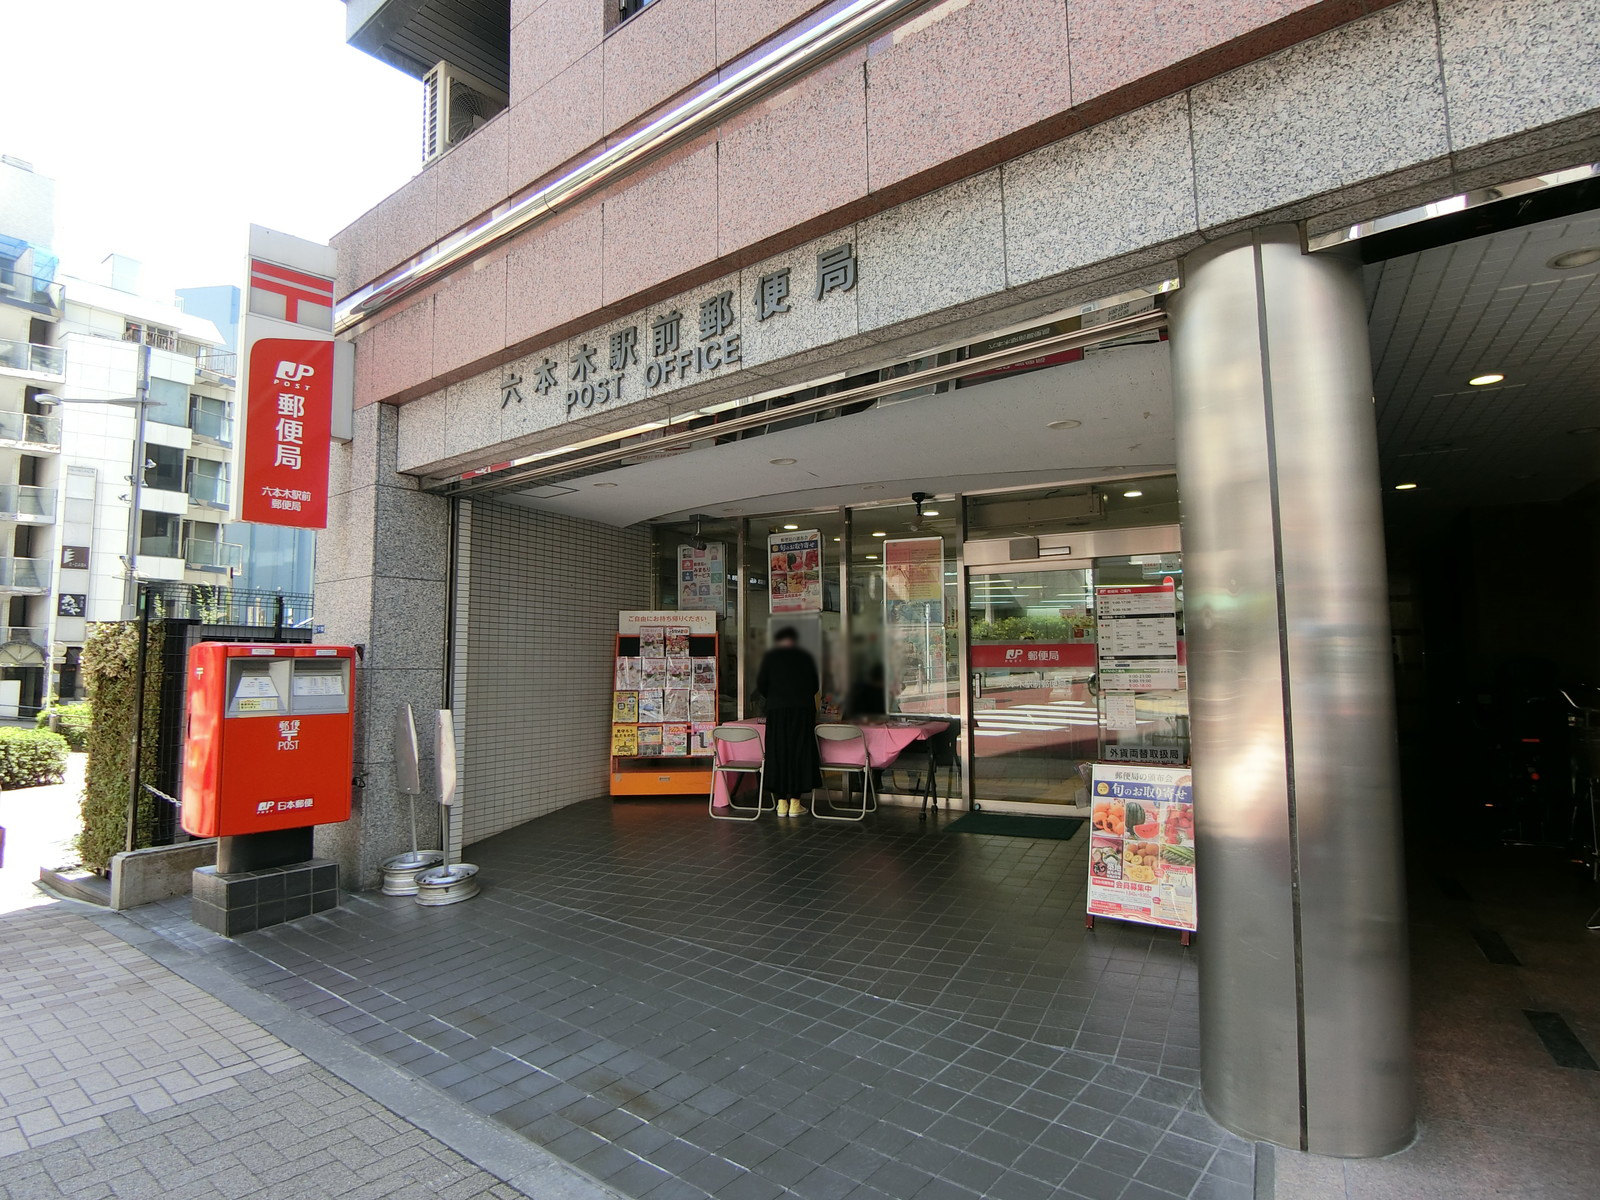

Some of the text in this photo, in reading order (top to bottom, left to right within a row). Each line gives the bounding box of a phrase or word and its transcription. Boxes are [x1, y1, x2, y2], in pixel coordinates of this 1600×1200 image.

[499, 243, 857, 409] 六本木駅前郵便局
[564, 333, 742, 413] POST OFFICE
[273, 378, 312, 391] POST
[274, 393, 305, 470] 郵便局
[261, 486, 312, 502] 六本木駅前
[271, 498, 302, 512] 郵便局
[628, 615, 707, 623] ご自由にお持ち帰りください
[1027, 650, 1060, 661] 郵便局
[278, 720, 300, 731] 郵便
[278, 740, 299, 750] POST
[1110, 748, 1179, 760] 外貨両替取扱局
[1112, 782, 1187, 800] 旬のお取り寄せ
[278, 798, 314, 811] 日本郵便
